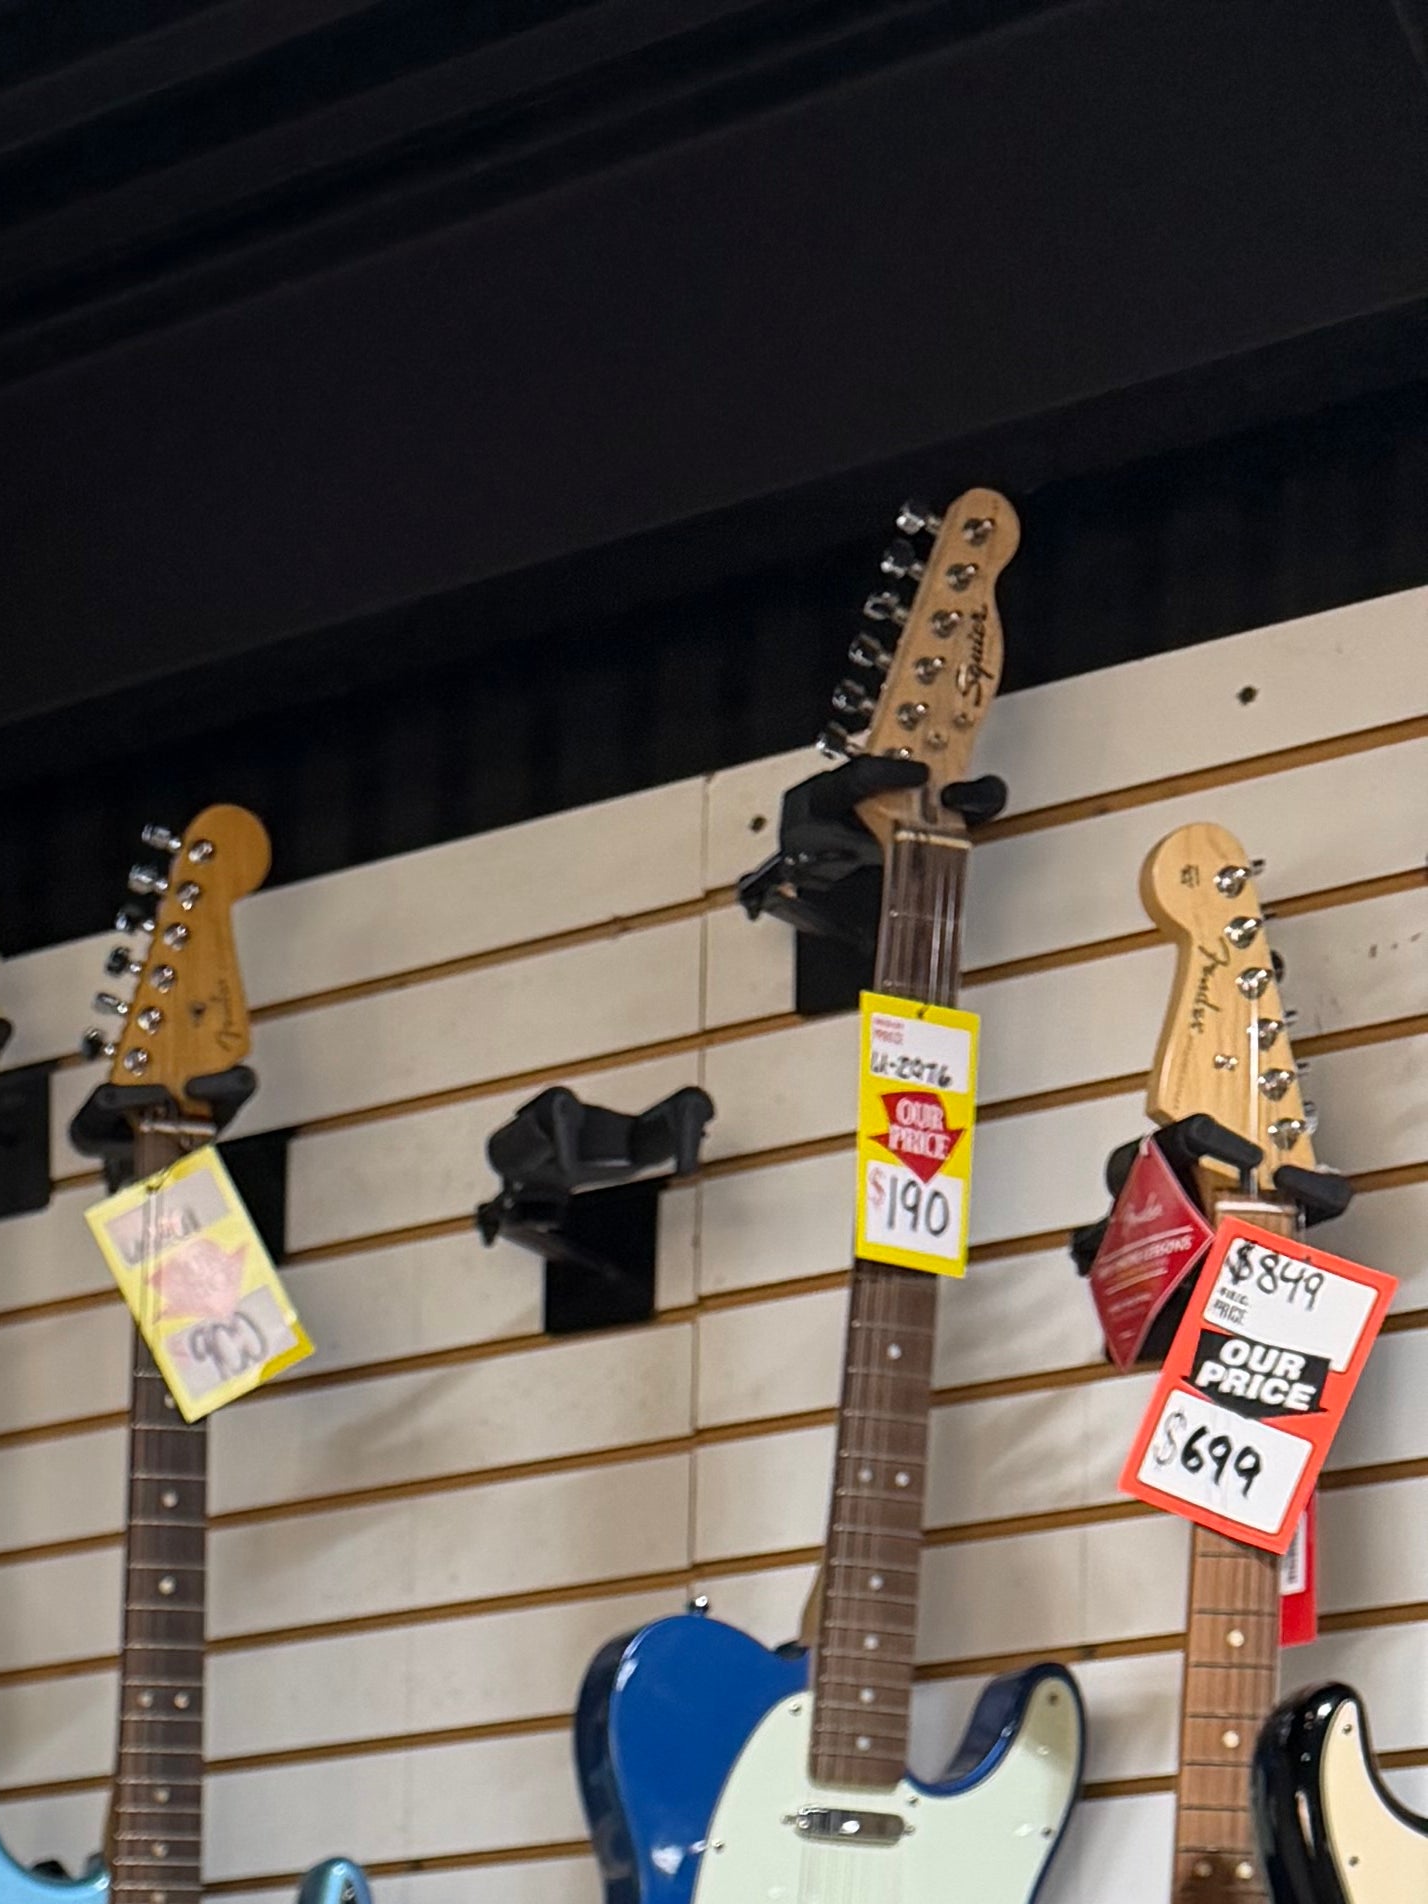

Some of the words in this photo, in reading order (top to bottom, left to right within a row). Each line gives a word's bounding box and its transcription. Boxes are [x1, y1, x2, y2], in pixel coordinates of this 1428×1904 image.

[956, 601, 994, 707] Squier
[887, 1125, 952, 1161] PRICE
[896, 1096, 944, 1131] OUR
[867, 1166, 951, 1238] $190
[1224, 1238, 1325, 1312] $849
[1194, 1360, 1317, 1413] PRICE
[1218, 1339, 1307, 1383] OUR
[1150, 1405, 1262, 1499] $699
